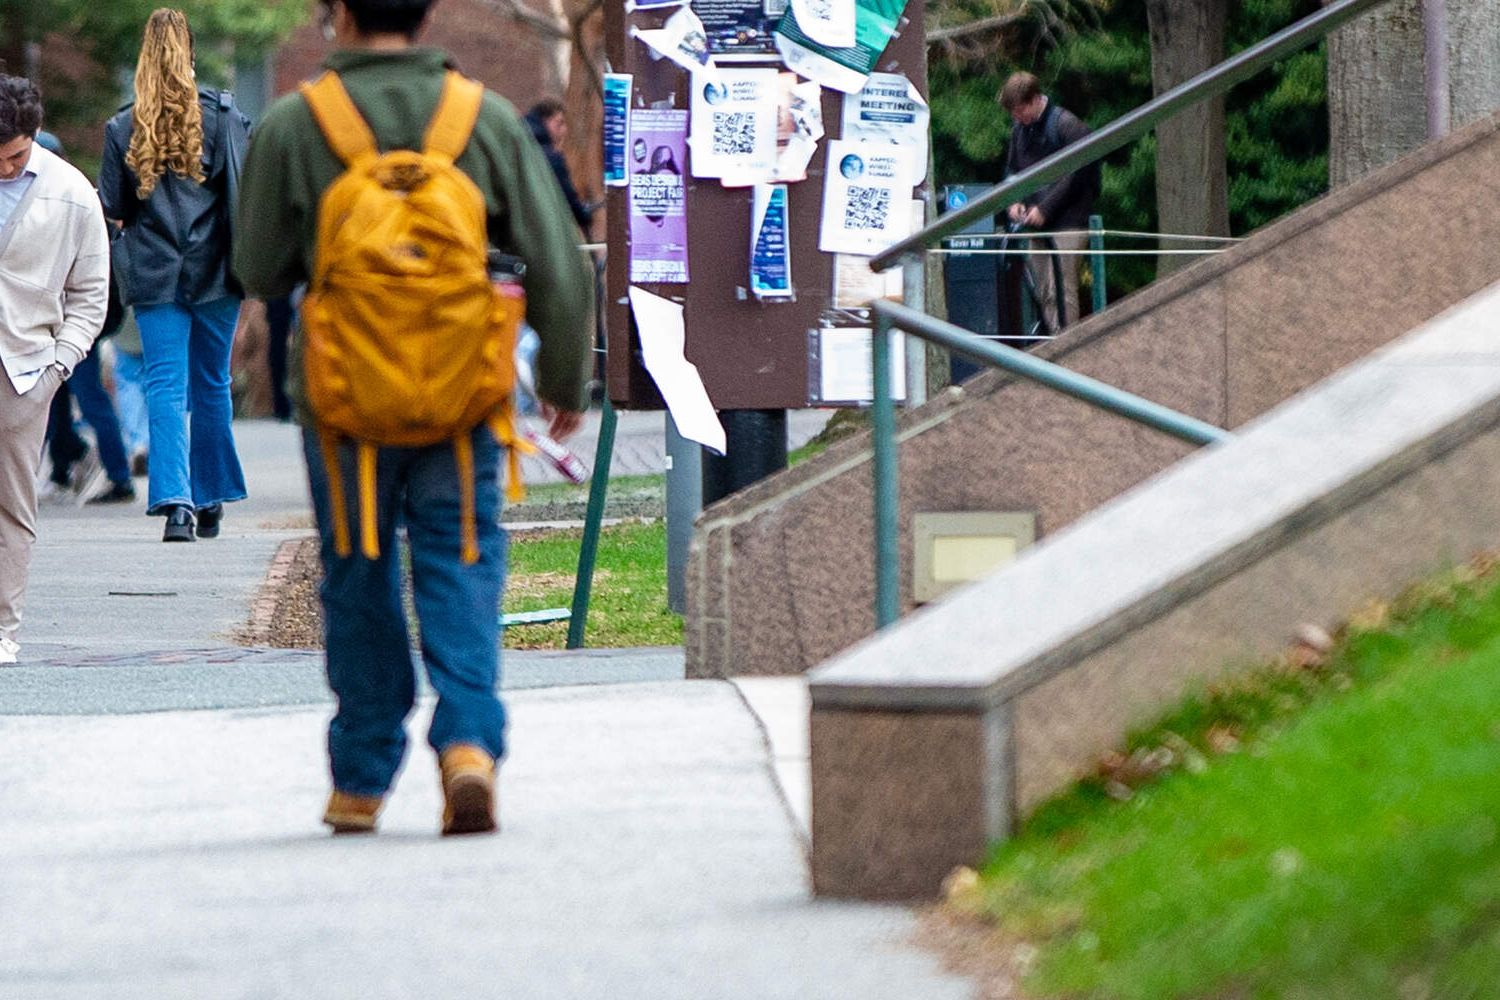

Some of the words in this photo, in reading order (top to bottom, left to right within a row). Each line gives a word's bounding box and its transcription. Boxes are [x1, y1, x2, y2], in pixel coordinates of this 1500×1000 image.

[860, 101, 915, 111] MEETING
[631, 186, 666, 198] PROJECT
[667, 186, 684, 198] FAIR
